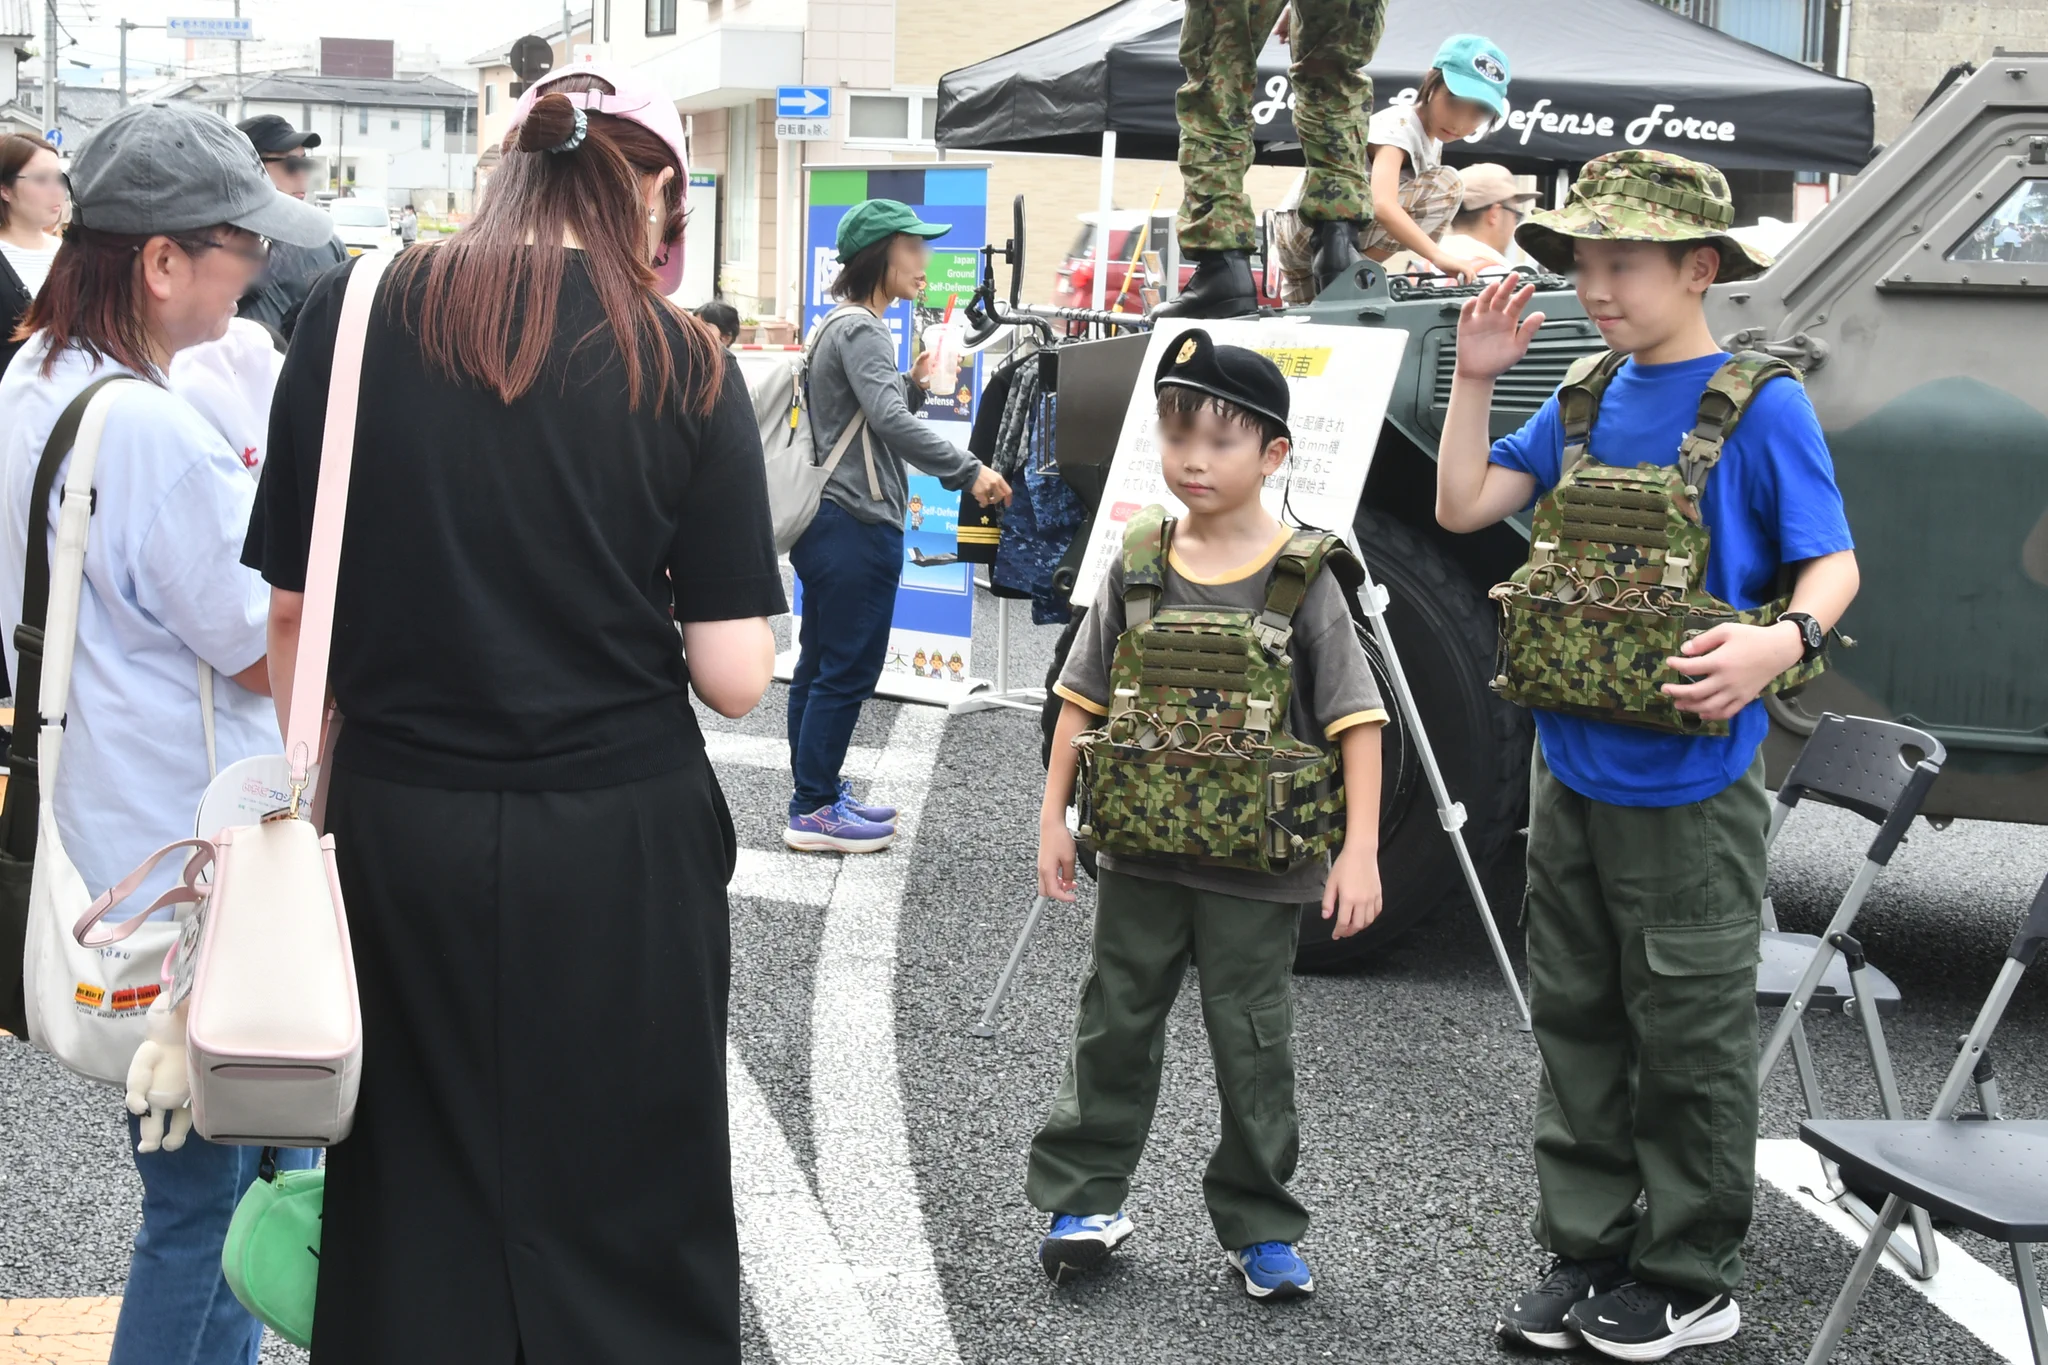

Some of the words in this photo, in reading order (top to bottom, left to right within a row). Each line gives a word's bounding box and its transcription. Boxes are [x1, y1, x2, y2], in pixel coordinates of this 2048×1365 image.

[777, 124, 829, 136] 自転車を除く
[1624, 103, 1736, 146] Force
[953, 255, 976, 266] Japan
[947, 268, 976, 278] Ground
[929, 282, 975, 293] Self-Defense
